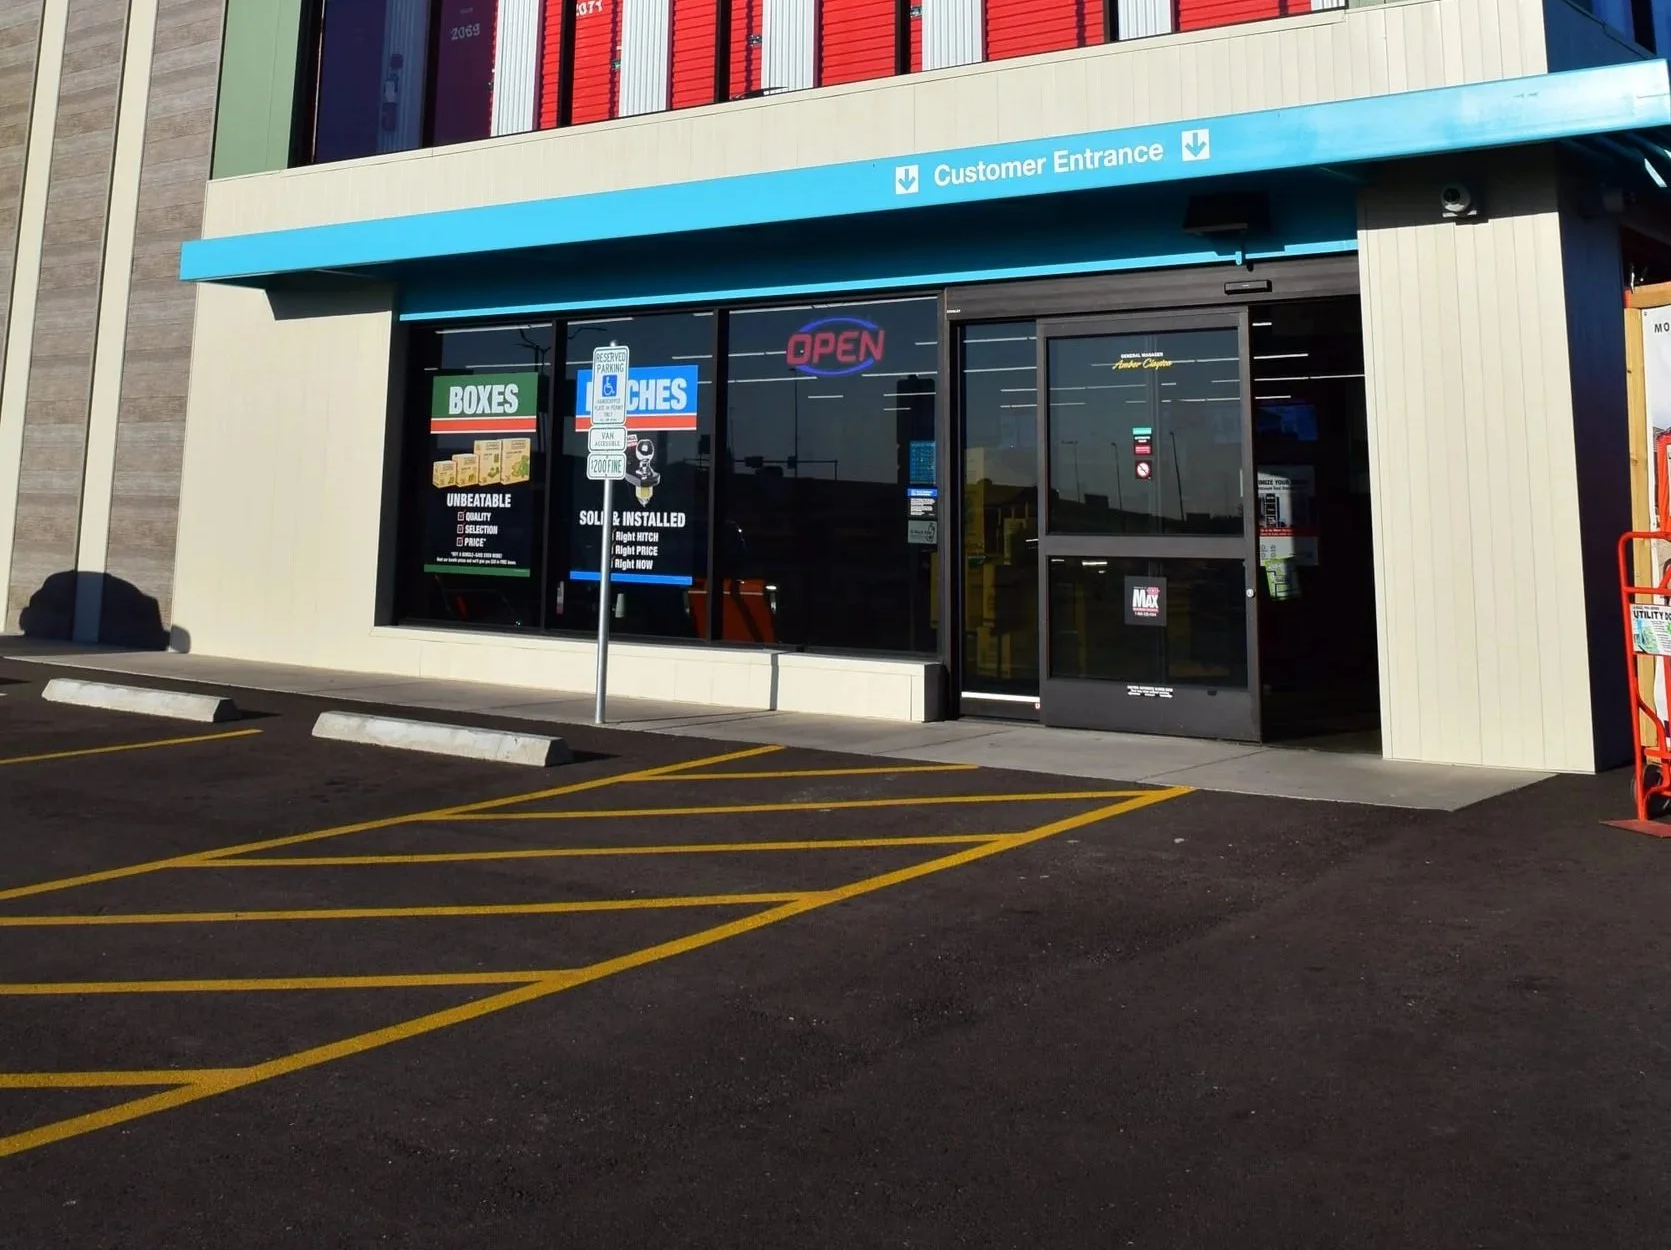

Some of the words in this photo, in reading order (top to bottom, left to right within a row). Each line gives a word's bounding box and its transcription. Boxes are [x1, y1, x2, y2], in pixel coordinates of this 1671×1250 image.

[450, 22, 481, 41] 2069
[934, 157, 1047, 187] Customer
[1053, 141, 1165, 174] Entrance
[785, 329, 886, 366] OPEN
[595, 351, 626, 363] RESERVED
[596, 363, 625, 374] PARKING
[448, 383, 519, 415] BOXES
[601, 432, 615, 440] VAN
[607, 458, 623, 474] FINE
[446, 493, 512, 508] UNBEATABLE
[465, 512, 492, 522] QUALITY
[612, 511, 620, 526] &
[622, 511, 686, 527] INSTALLED
[464, 524, 498, 535] SELECTION
[615, 531, 636, 543] Right
[636, 531, 659, 543] HITCH
[615, 544, 635, 557] Right
[636, 546, 658, 557] PRICE
[614, 558, 635, 571] Right
[635, 559, 654, 571] NOW
[1132, 588, 1159, 609] MAX
[1633, 610, 1664, 620] UTILITY
